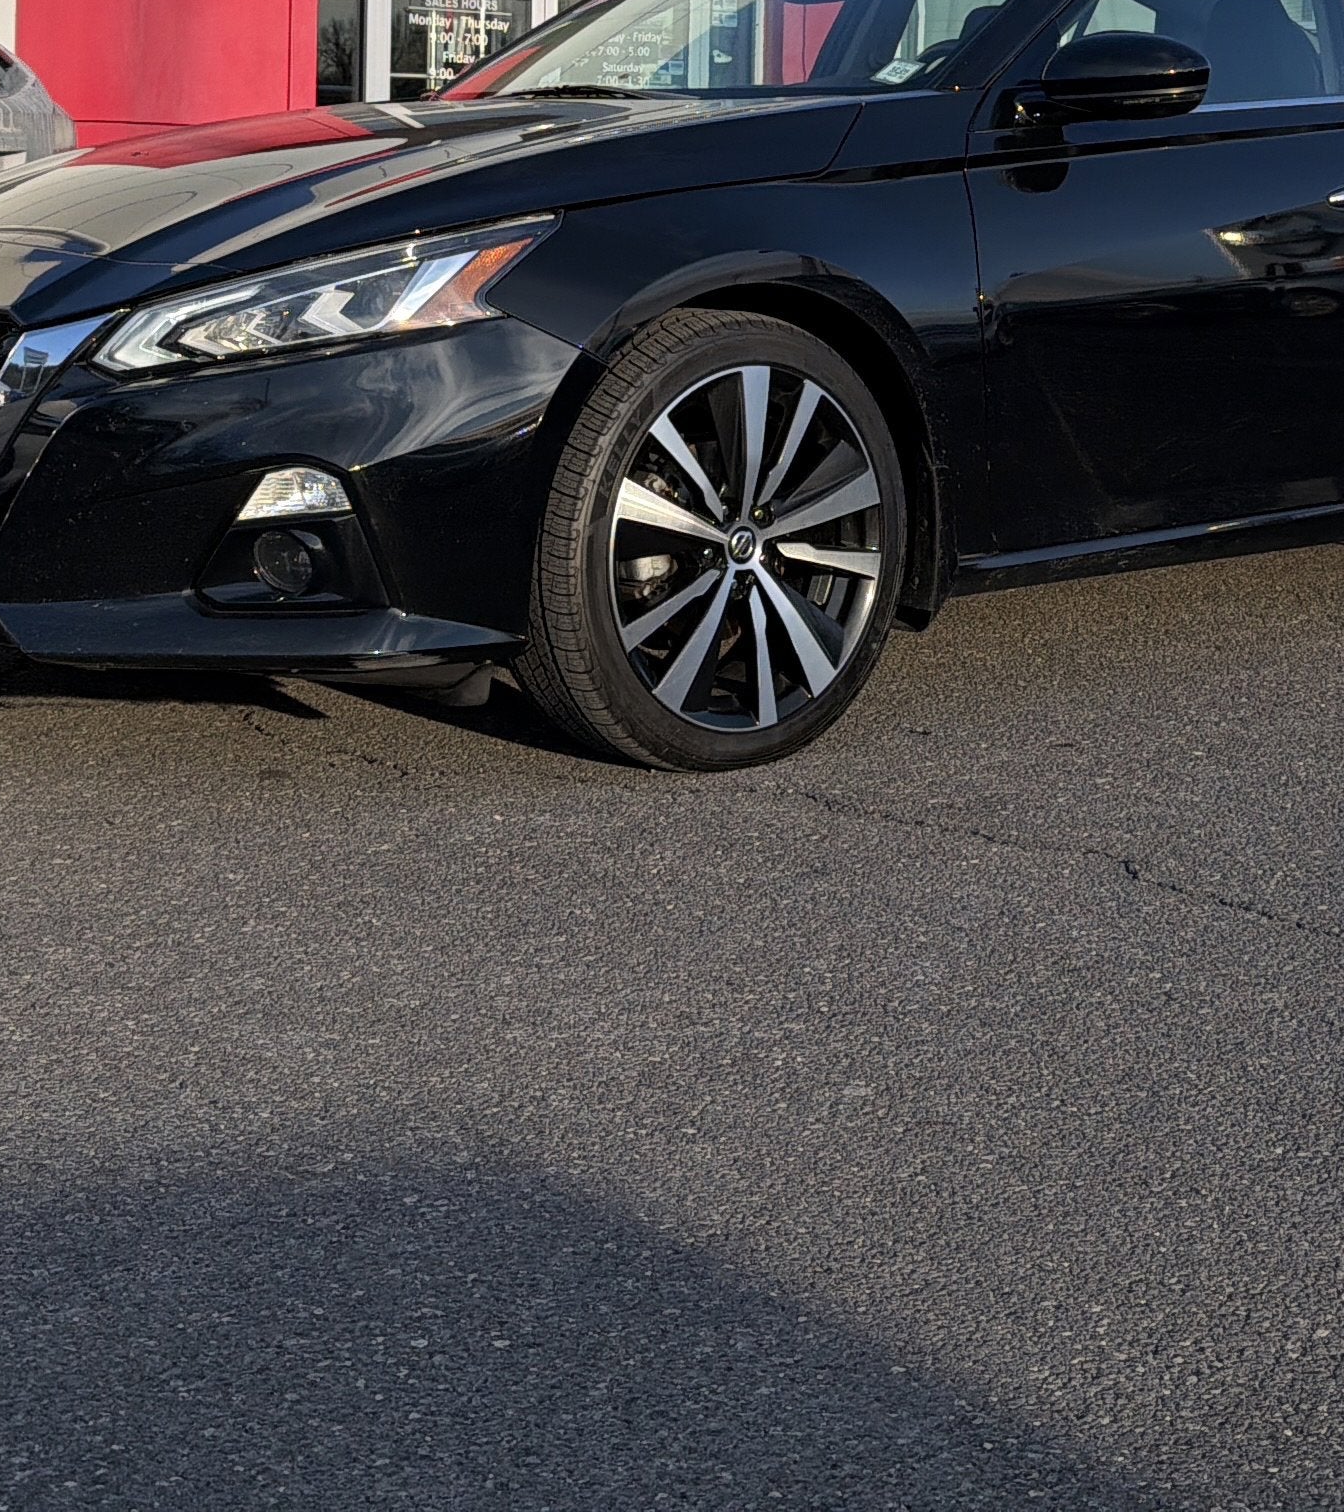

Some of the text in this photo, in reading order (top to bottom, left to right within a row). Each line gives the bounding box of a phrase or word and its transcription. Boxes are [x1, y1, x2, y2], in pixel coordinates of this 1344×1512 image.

[408, 13, 452, 29] Monday
[460, 15, 510, 33] Thursday
[632, 31, 662, 45] Friday
[442, 51, 476, 64] Friday
[602, 61, 643, 73] Saturday
